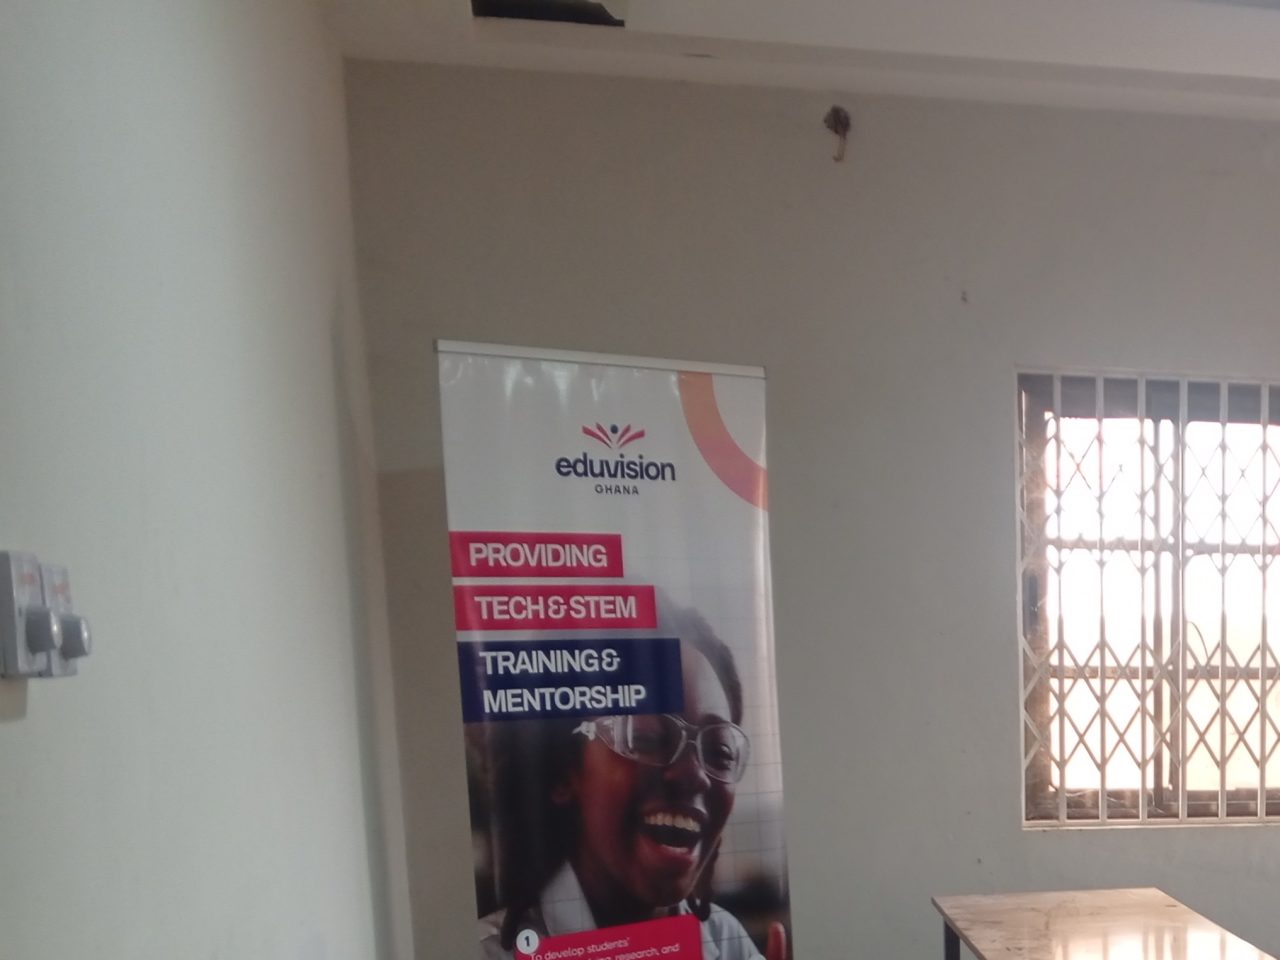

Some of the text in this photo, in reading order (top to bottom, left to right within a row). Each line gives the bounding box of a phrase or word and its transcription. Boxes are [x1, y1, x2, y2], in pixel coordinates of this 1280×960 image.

[555, 451, 676, 481] eduvision
[594, 483, 640, 495] GHANA
[468, 542, 608, 568] PROVIDING
[473, 595, 545, 620] TECH
[569, 595, 638, 619] STEM
[478, 648, 600, 675] TRAINING
[482, 684, 647, 714] MENTORSHIP
[524, 935, 531, 947] 1
[544, 945, 585, 960] develop
[660, 943, 680, 955] and
